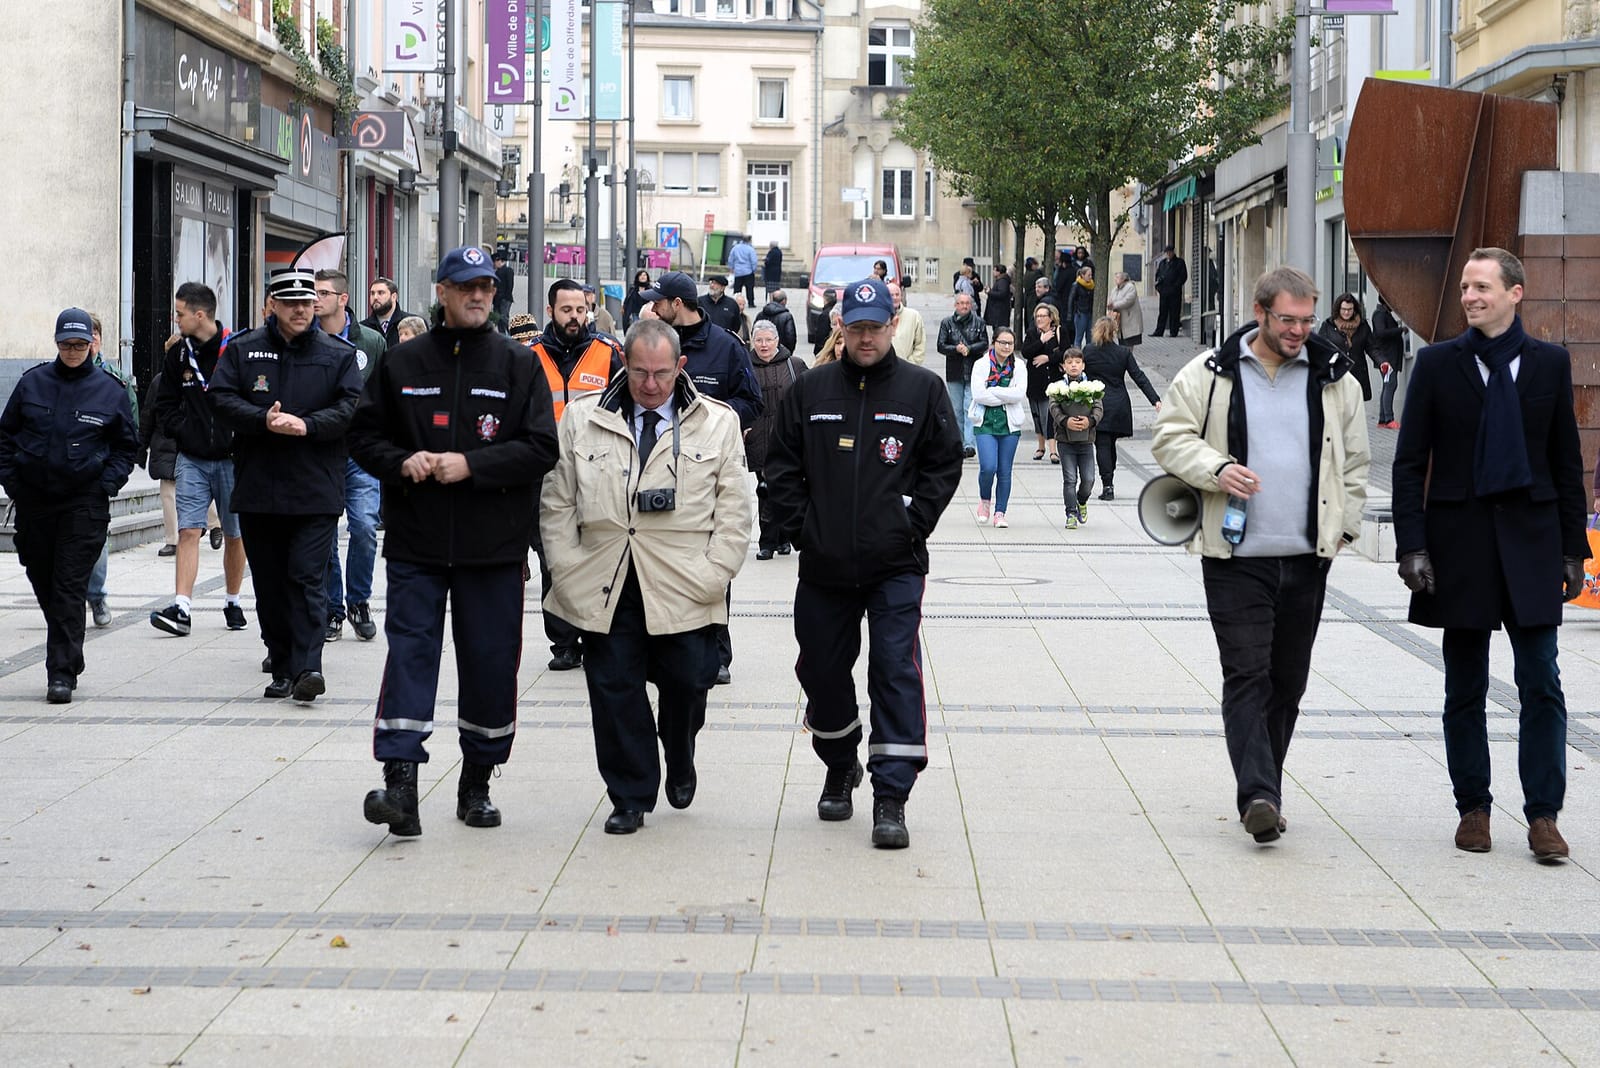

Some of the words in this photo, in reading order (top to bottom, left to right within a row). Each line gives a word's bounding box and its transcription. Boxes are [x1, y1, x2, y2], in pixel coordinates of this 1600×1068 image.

[508, 16, 517, 31] de
[508, 34, 517, 59] Ville
[566, 47, 574, 60] de
[178, 54, 198, 105] Cap
[566, 62, 574, 83] Ville
[175, 182, 200, 207] SALON
[207, 190, 231, 215] PAULA
[248, 351, 279, 360] POLICE
[582, 375, 605, 386] POLICE
